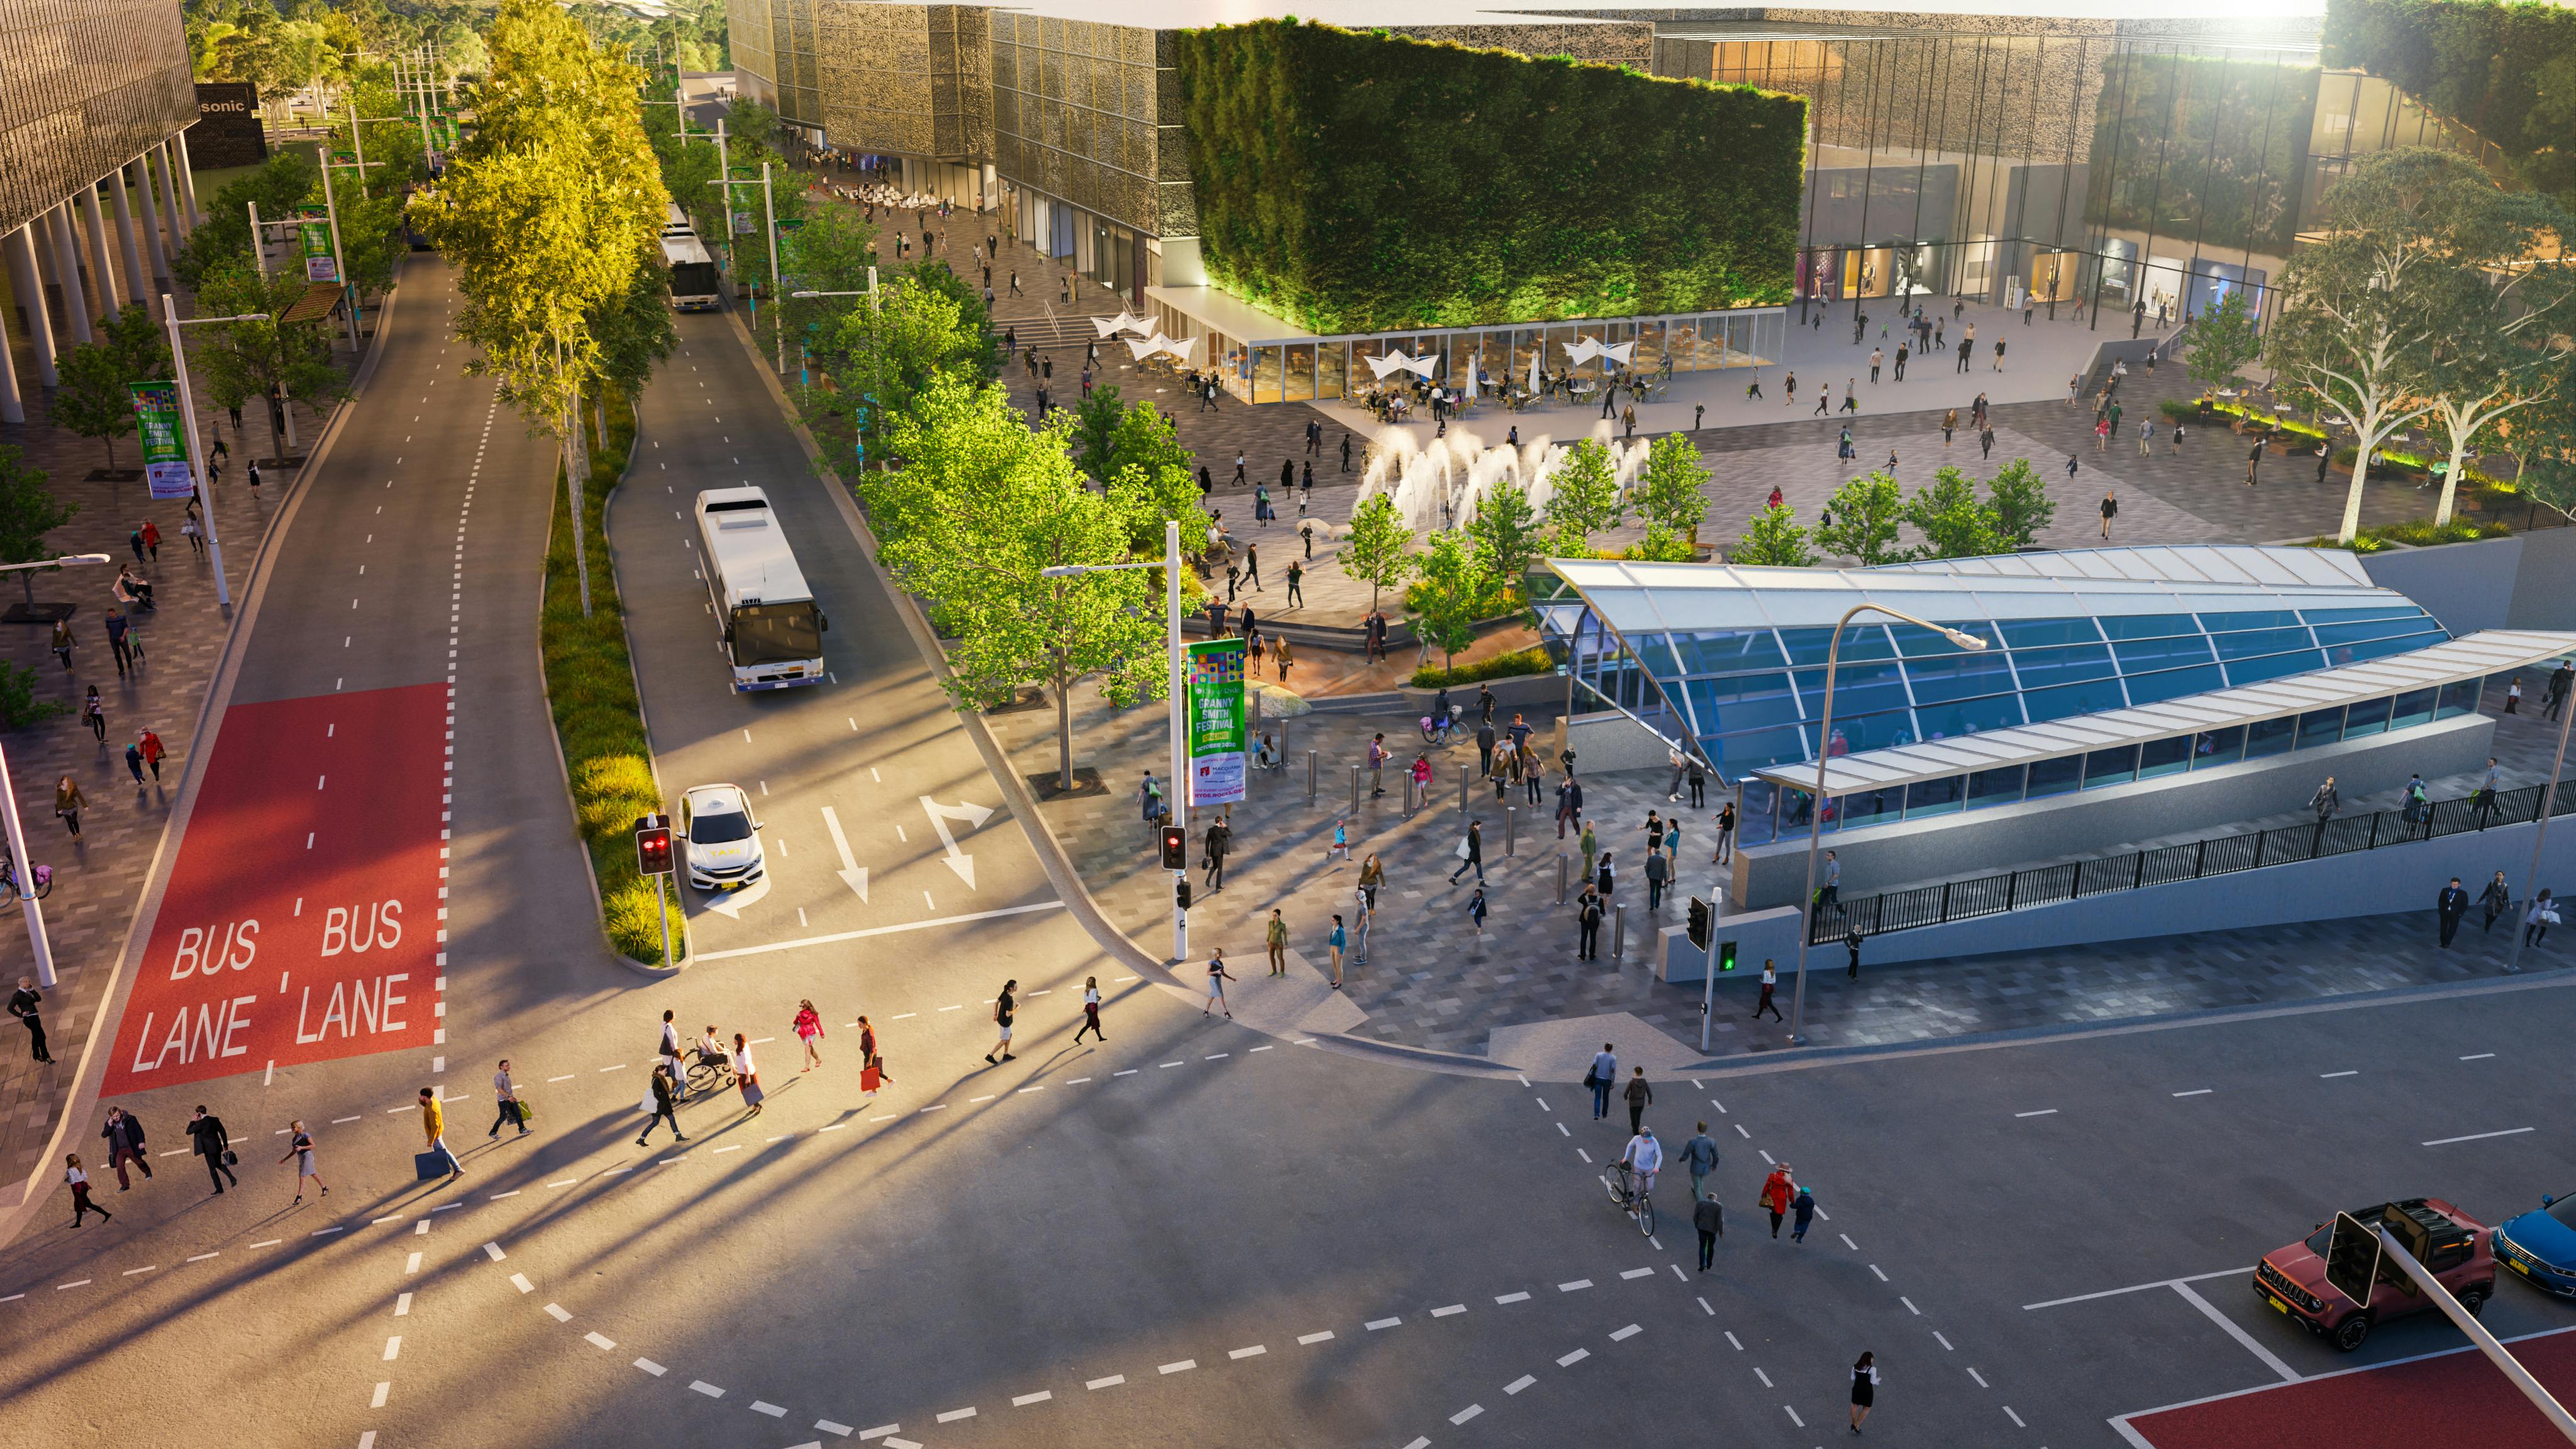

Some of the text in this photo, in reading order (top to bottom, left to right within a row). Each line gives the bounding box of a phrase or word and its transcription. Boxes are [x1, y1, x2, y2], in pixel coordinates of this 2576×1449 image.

[145, 438, 176, 447] FESTIVAL
[1199, 697, 1234, 709] GRANNY
[1202, 709, 1229, 719] SMITH
[1196, 719, 1235, 733] FESTIVAL
[1204, 733, 1228, 741] ONLINE
[1196, 743, 1221, 752] OCTOBER
[711, 847, 740, 857] TAXI
[321, 900, 402, 957] BUS
[170, 919, 259, 980] BUS
[297, 974, 409, 1045] LANE
[132, 996, 257, 1073] LANE
